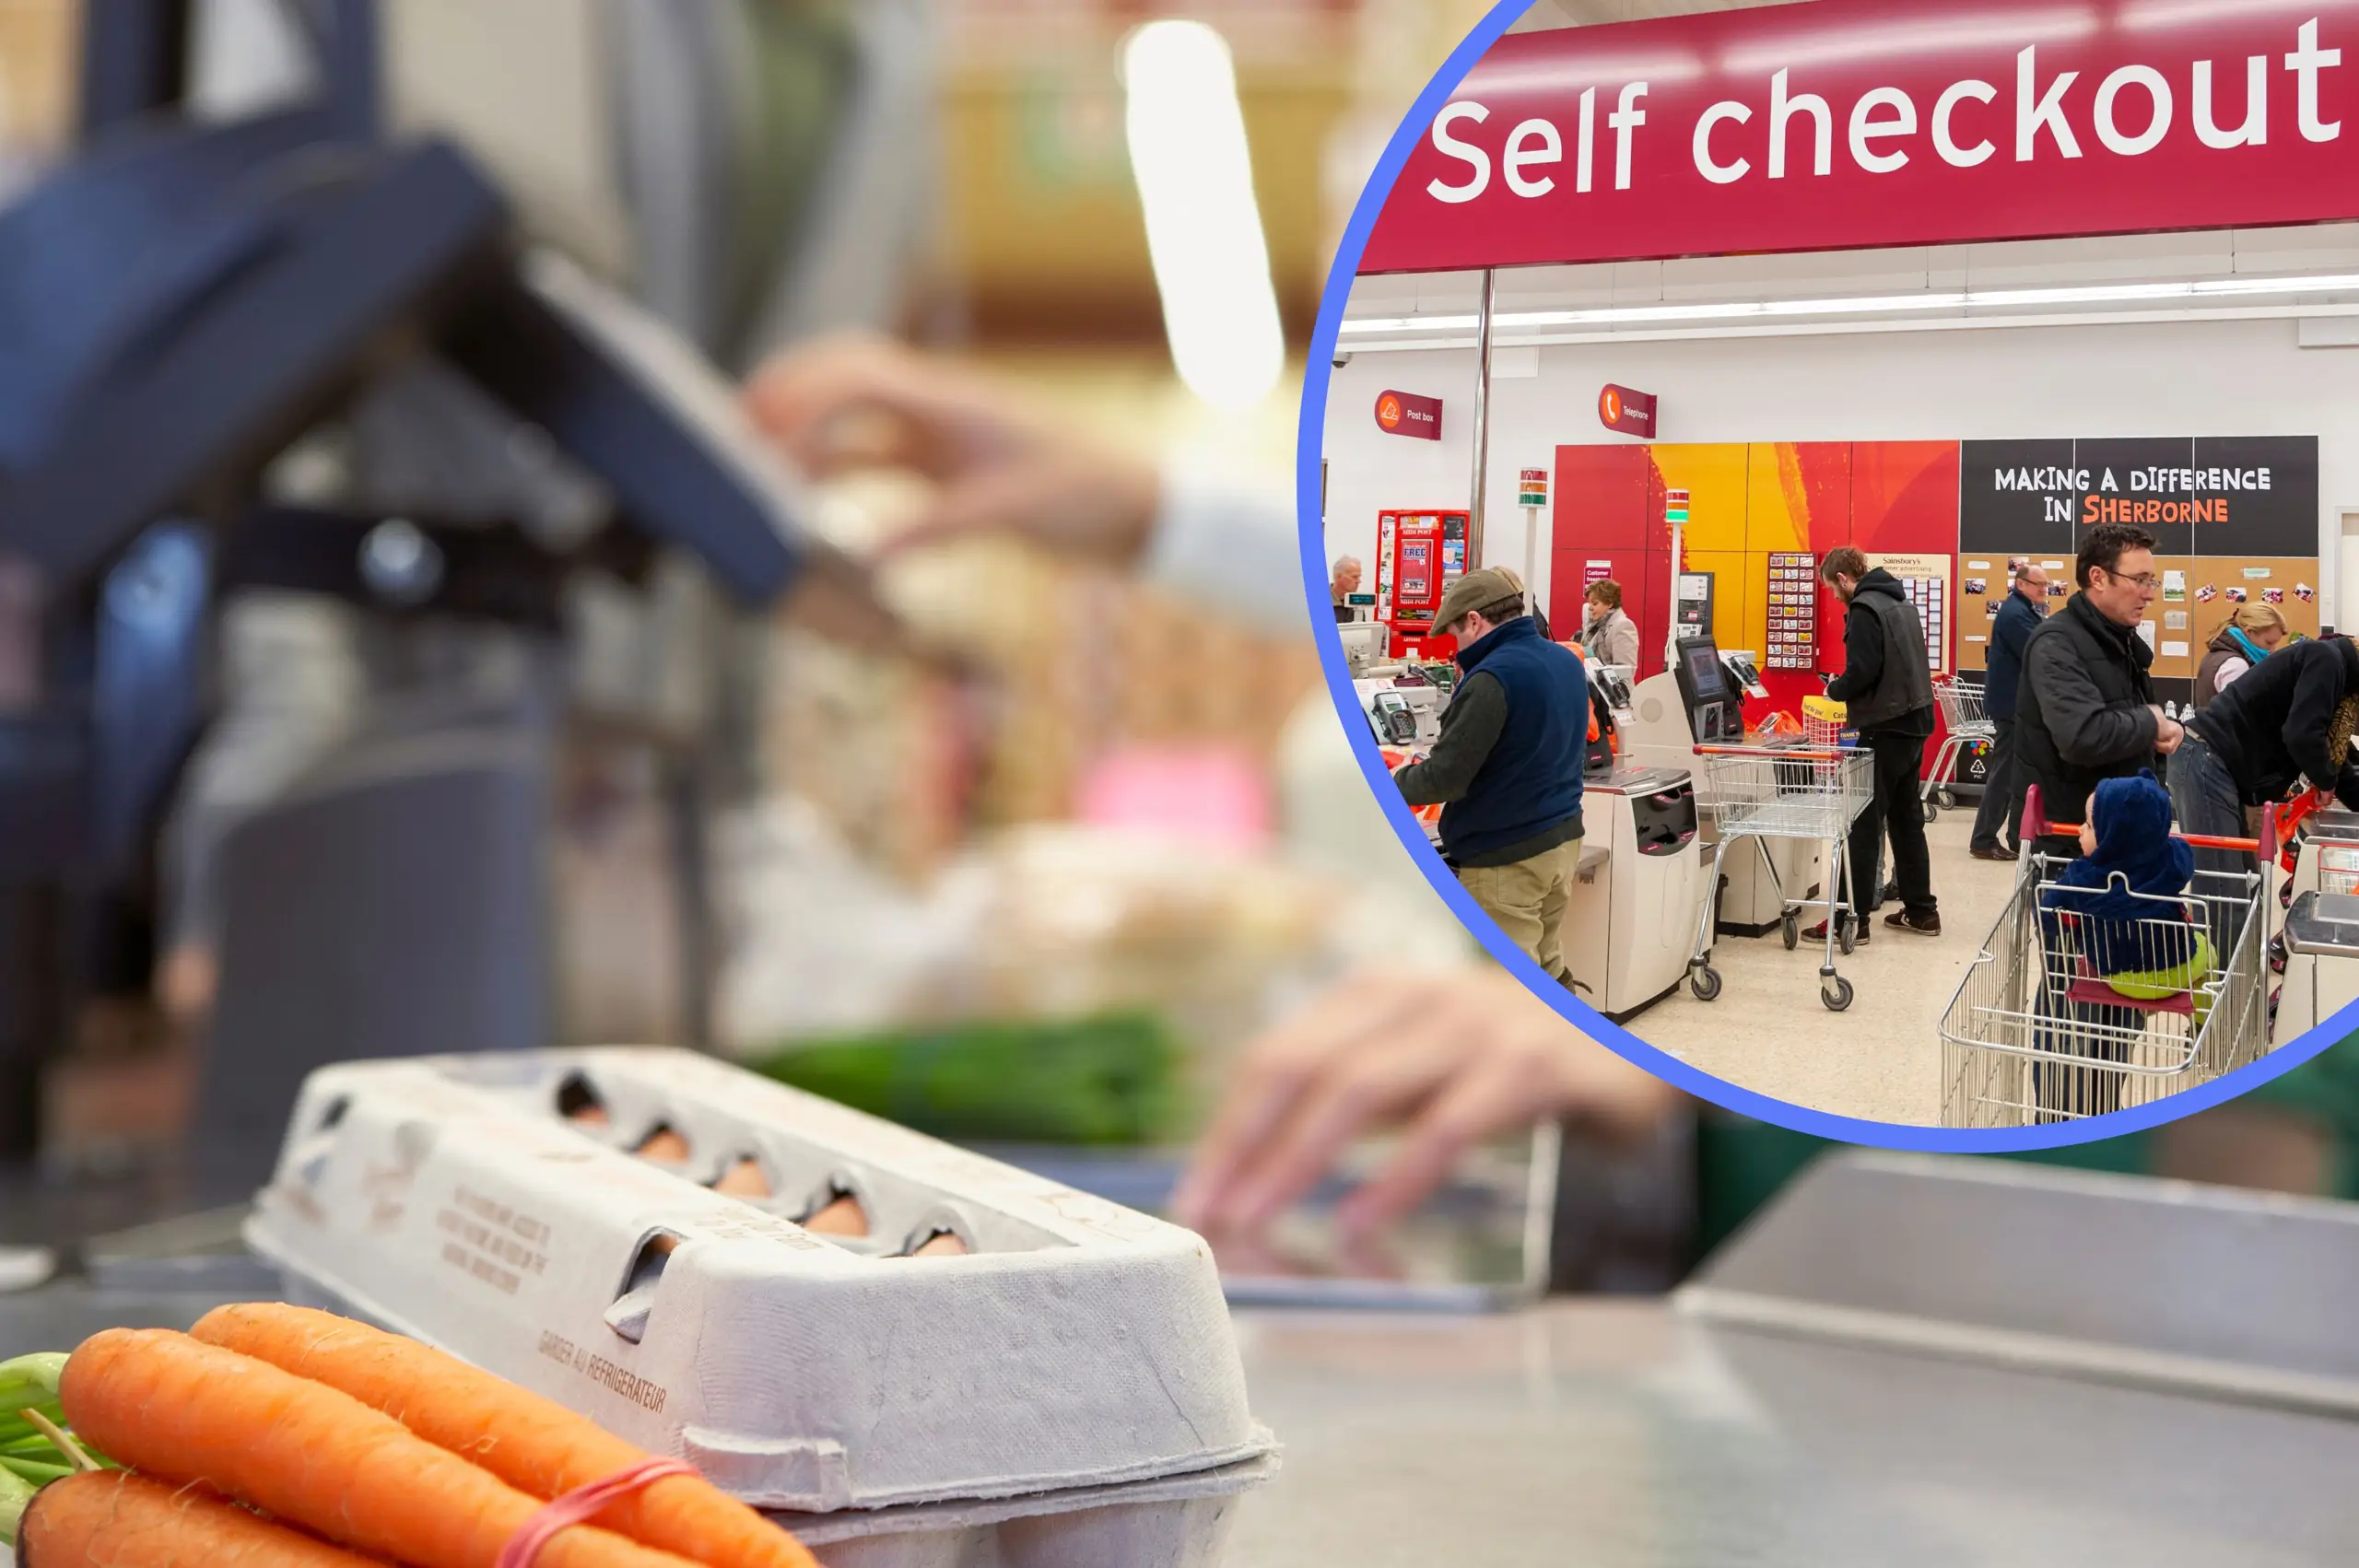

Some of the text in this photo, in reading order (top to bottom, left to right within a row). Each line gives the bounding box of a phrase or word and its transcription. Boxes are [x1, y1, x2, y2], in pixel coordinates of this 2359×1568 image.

[1426, 17, 2341, 204] Self checkout
[1407, 409, 1434, 422] Post box
[1623, 405, 1649, 420] Telephone
[1994, 466, 2271, 492] MAKING A DIFFERENCE
[2044, 494, 2228, 523] IN SHERBORNE
[1403, 548, 1426, 556] FREE
[1883, 556, 1920, 566] Sainsbury's
[586, 1353, 667, 1414] REFRIGERATEUR
